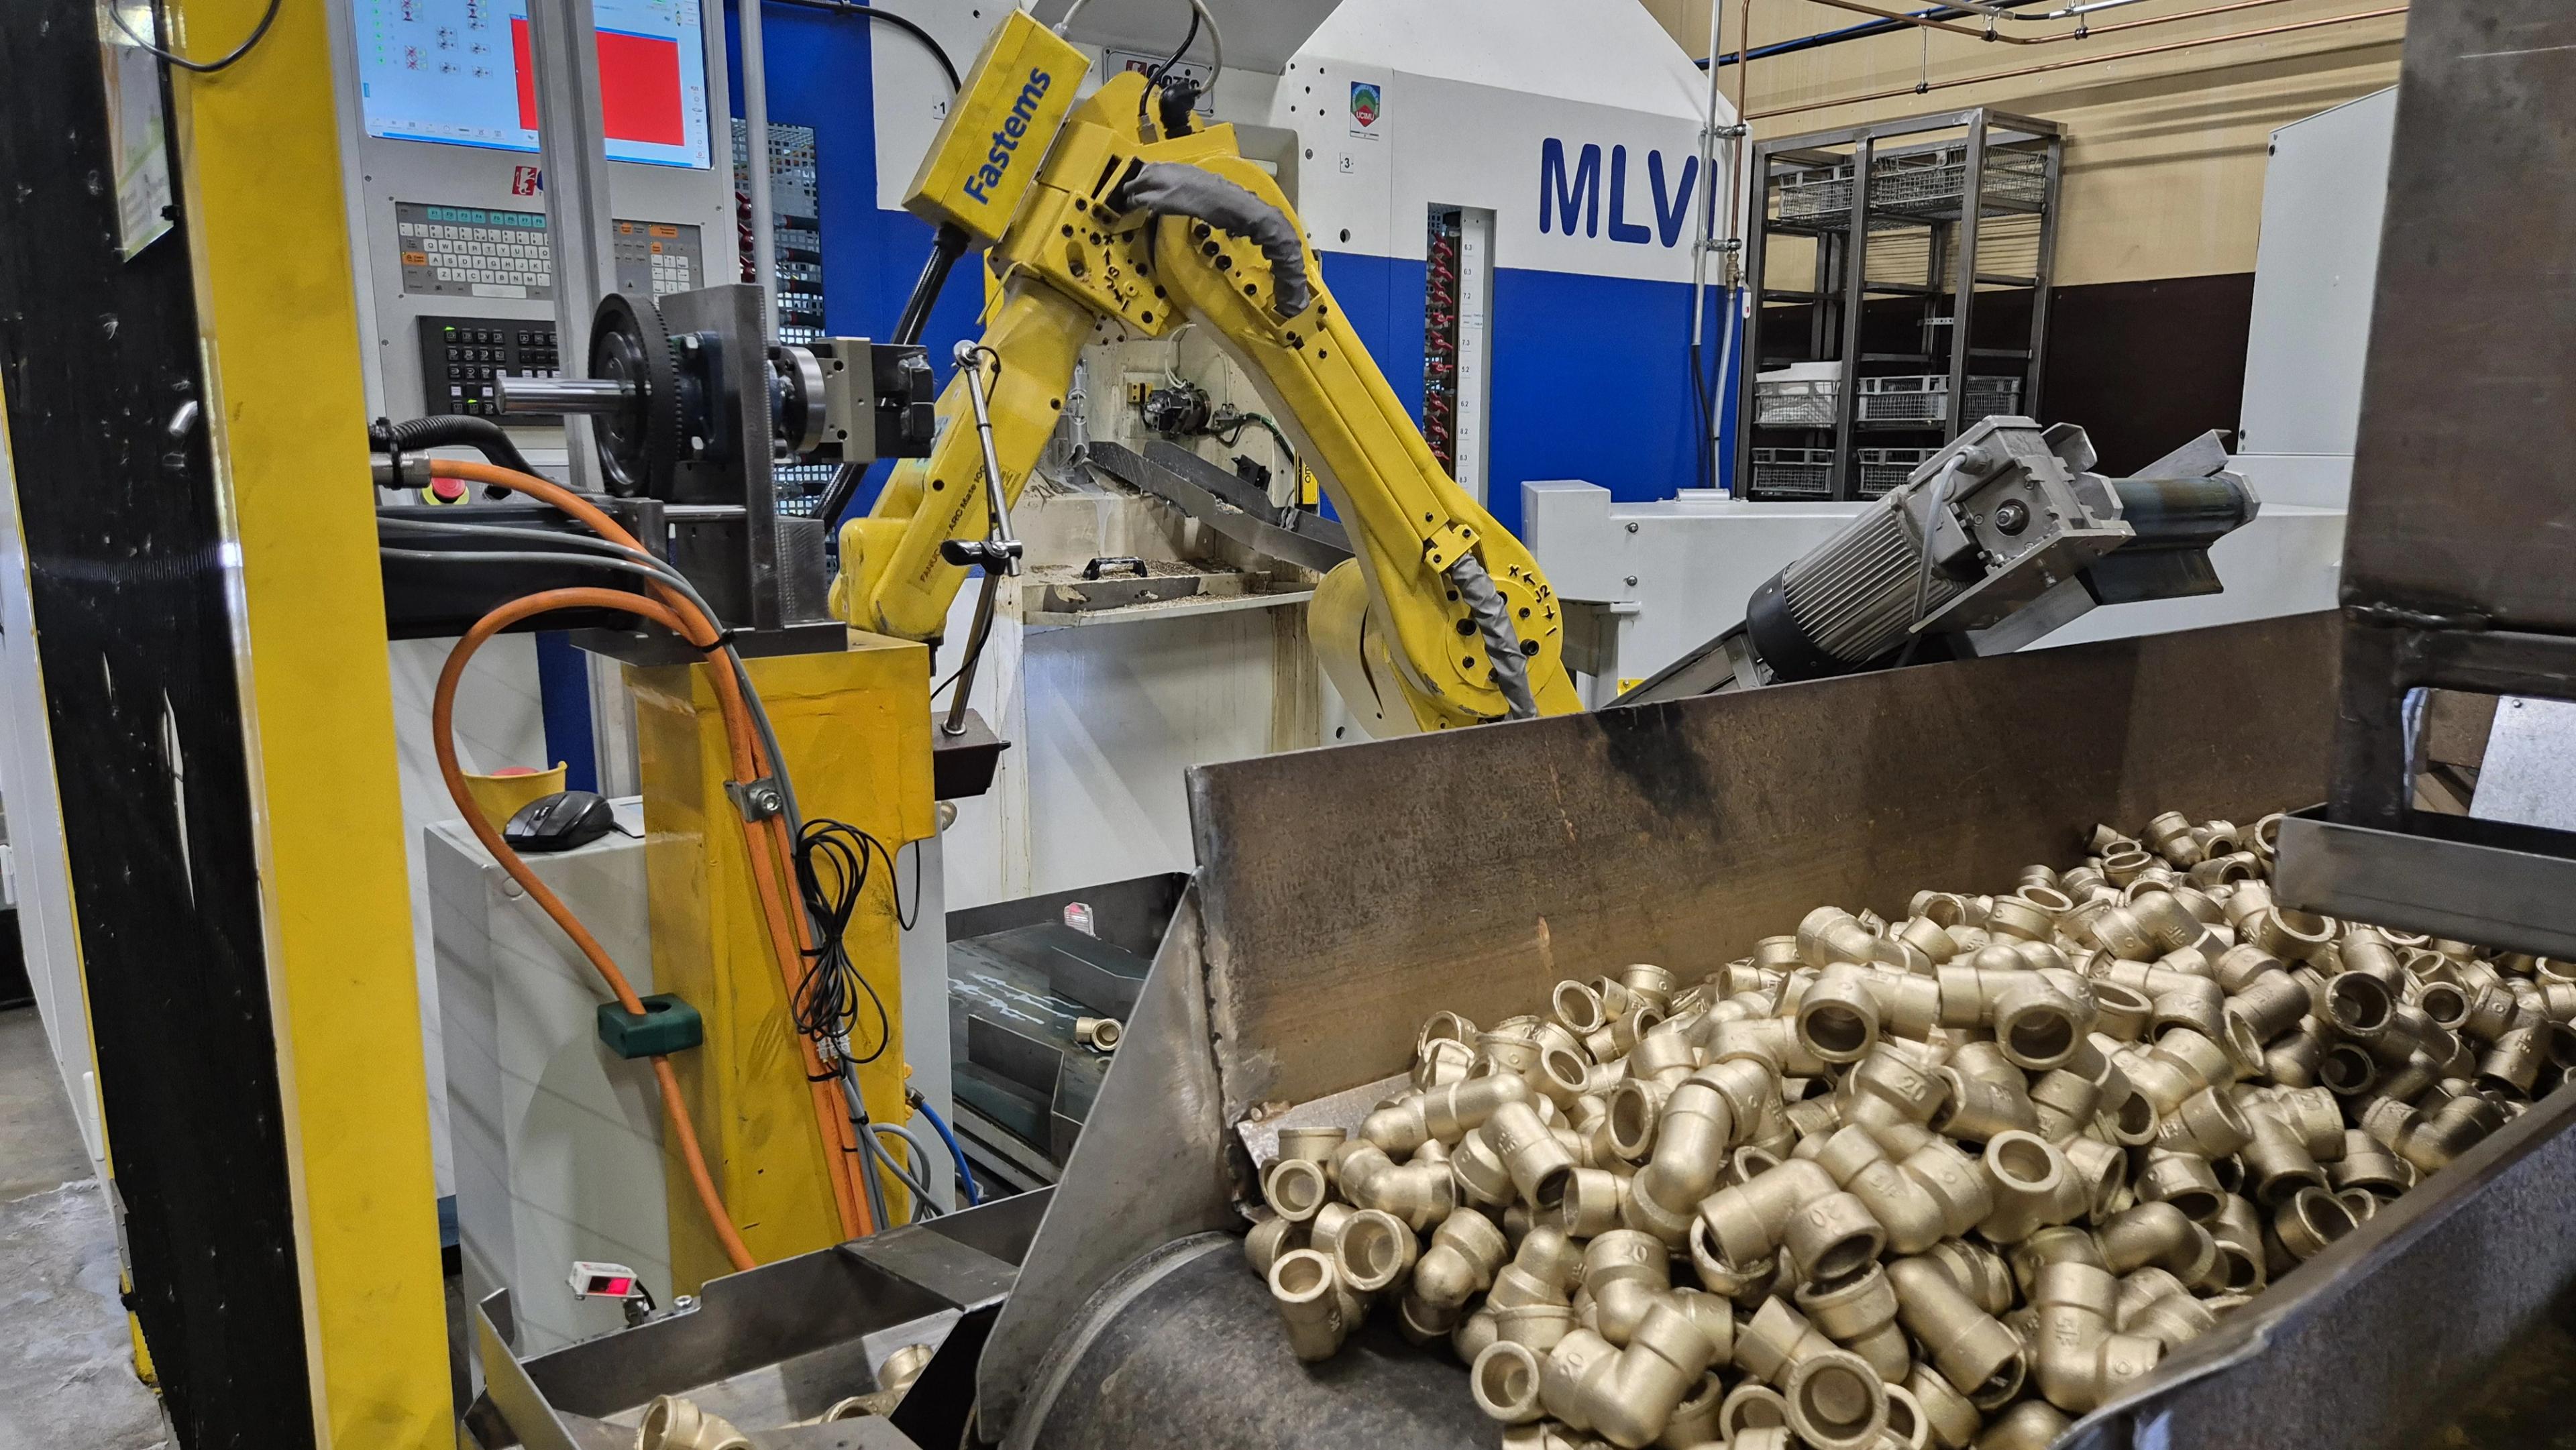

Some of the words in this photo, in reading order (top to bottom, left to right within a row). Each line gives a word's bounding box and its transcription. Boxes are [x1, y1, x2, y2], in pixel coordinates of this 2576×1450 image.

[940, 101, 945, 114] 1
[1356, 111, 1375, 121] UCIMU
[963, 67, 1051, 205] Fastems
[1344, 158, 1350, 168] 3
[949, 508, 963, 531] ARC
[960, 484, 977, 510] Mate
[1534, 584, 1552, 604] J2
[1896, 1074, 1927, 1102] 20
[1615, 1243, 1648, 1262] 20
